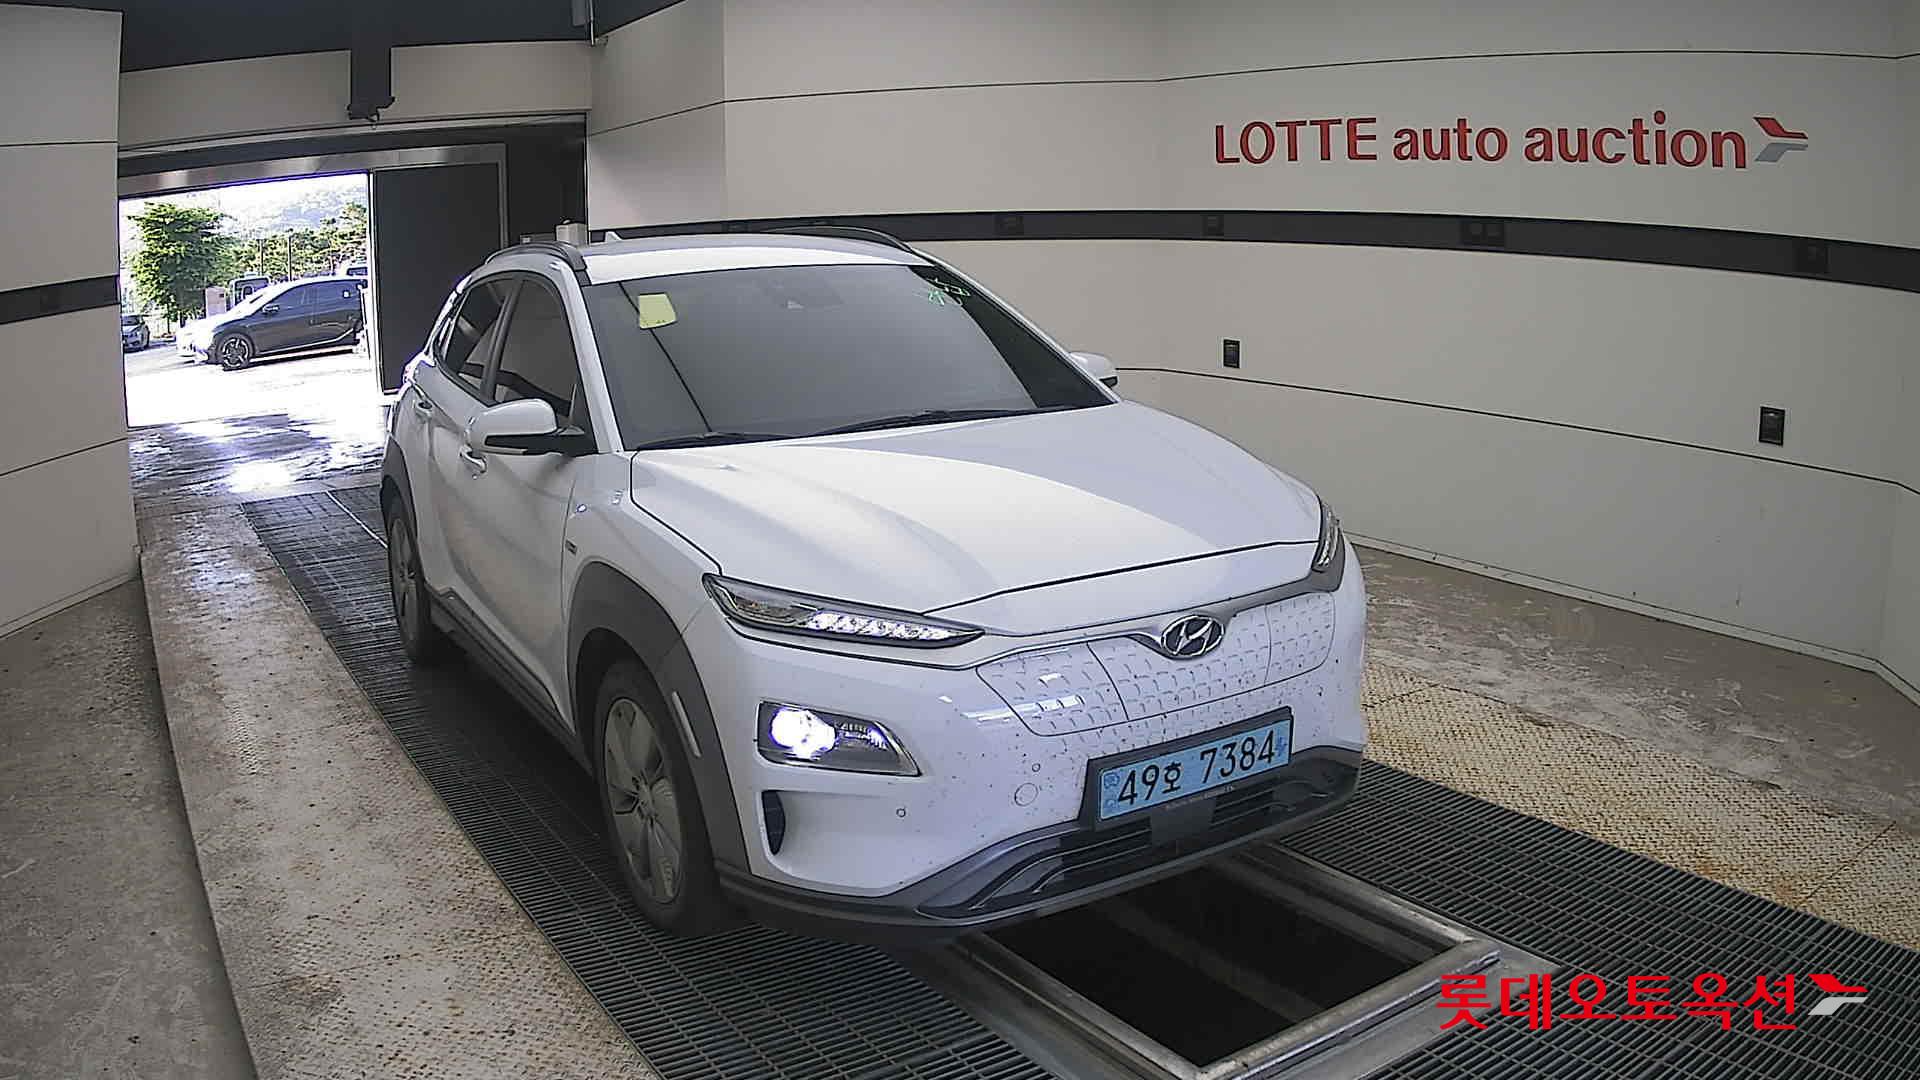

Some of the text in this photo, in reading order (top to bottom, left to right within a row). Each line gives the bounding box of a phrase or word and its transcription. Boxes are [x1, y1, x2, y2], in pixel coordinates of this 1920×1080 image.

[1215, 110, 1747, 169] LOTTE auto auction
[1118, 760, 1182, 806] 49호
[1200, 730, 1275, 784] 7384
